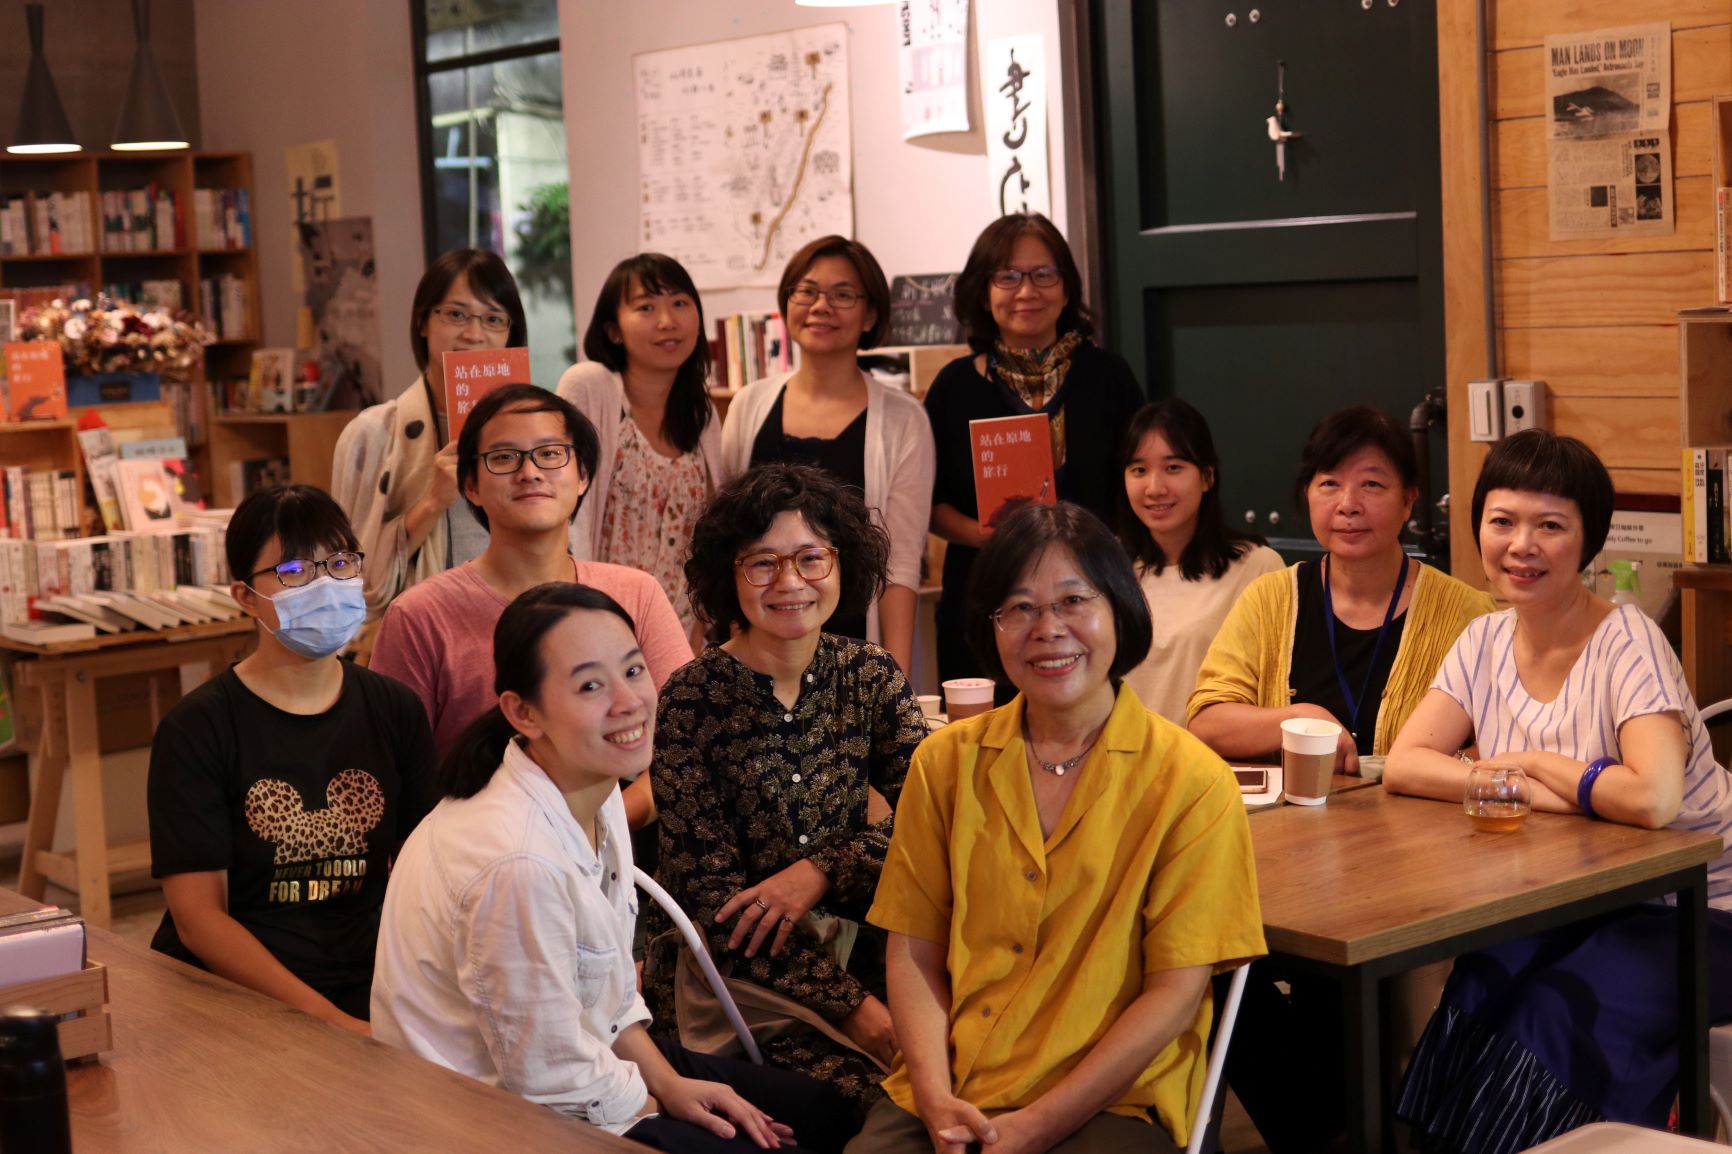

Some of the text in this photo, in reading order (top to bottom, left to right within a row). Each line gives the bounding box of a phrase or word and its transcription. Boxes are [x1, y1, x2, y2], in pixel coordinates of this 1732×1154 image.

[1551, 47, 1571, 67] MAN
[1573, 43, 1601, 65] LANDS
[1604, 41, 1616, 60] ON
[1618, 38, 1645, 59] MOON
[455, 362, 510, 379] 站在原地
[456, 383, 469, 397] 的
[980, 430, 1032, 447] 站在原地
[981, 450, 994, 462] 的
[983, 464, 1008, 478] 旅行
[1617, 535, 1636, 543] Coffee
[273, 864, 313, 880] NEVER
[268, 880, 300, 903] FOR
